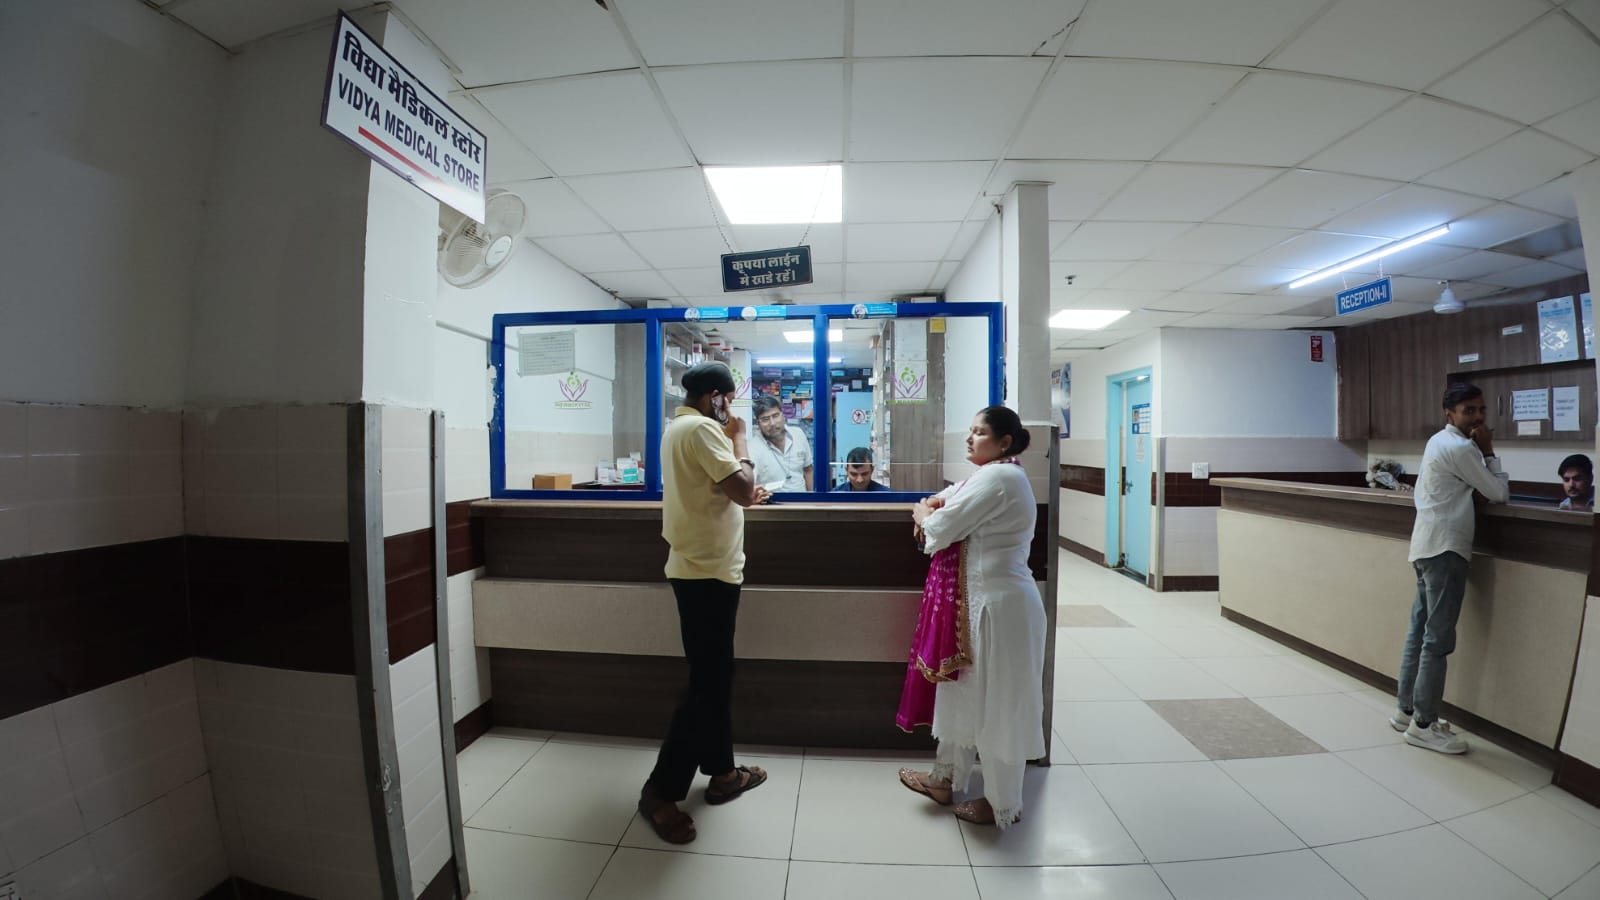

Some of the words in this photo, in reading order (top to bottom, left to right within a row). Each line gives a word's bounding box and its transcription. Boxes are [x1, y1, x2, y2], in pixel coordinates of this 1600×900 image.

[338, 72, 381, 126] VIDYA
[384, 108, 440, 168] MEDICAL
[443, 155, 480, 193] STORE
[388, 65, 449, 139] मैडिकल
[451, 132, 482, 164] स्टोर
[731, 257, 766, 274] कृपया
[767, 252, 800, 267] लाईन
[1340, 284, 1387, 311] RECEPTION-II
